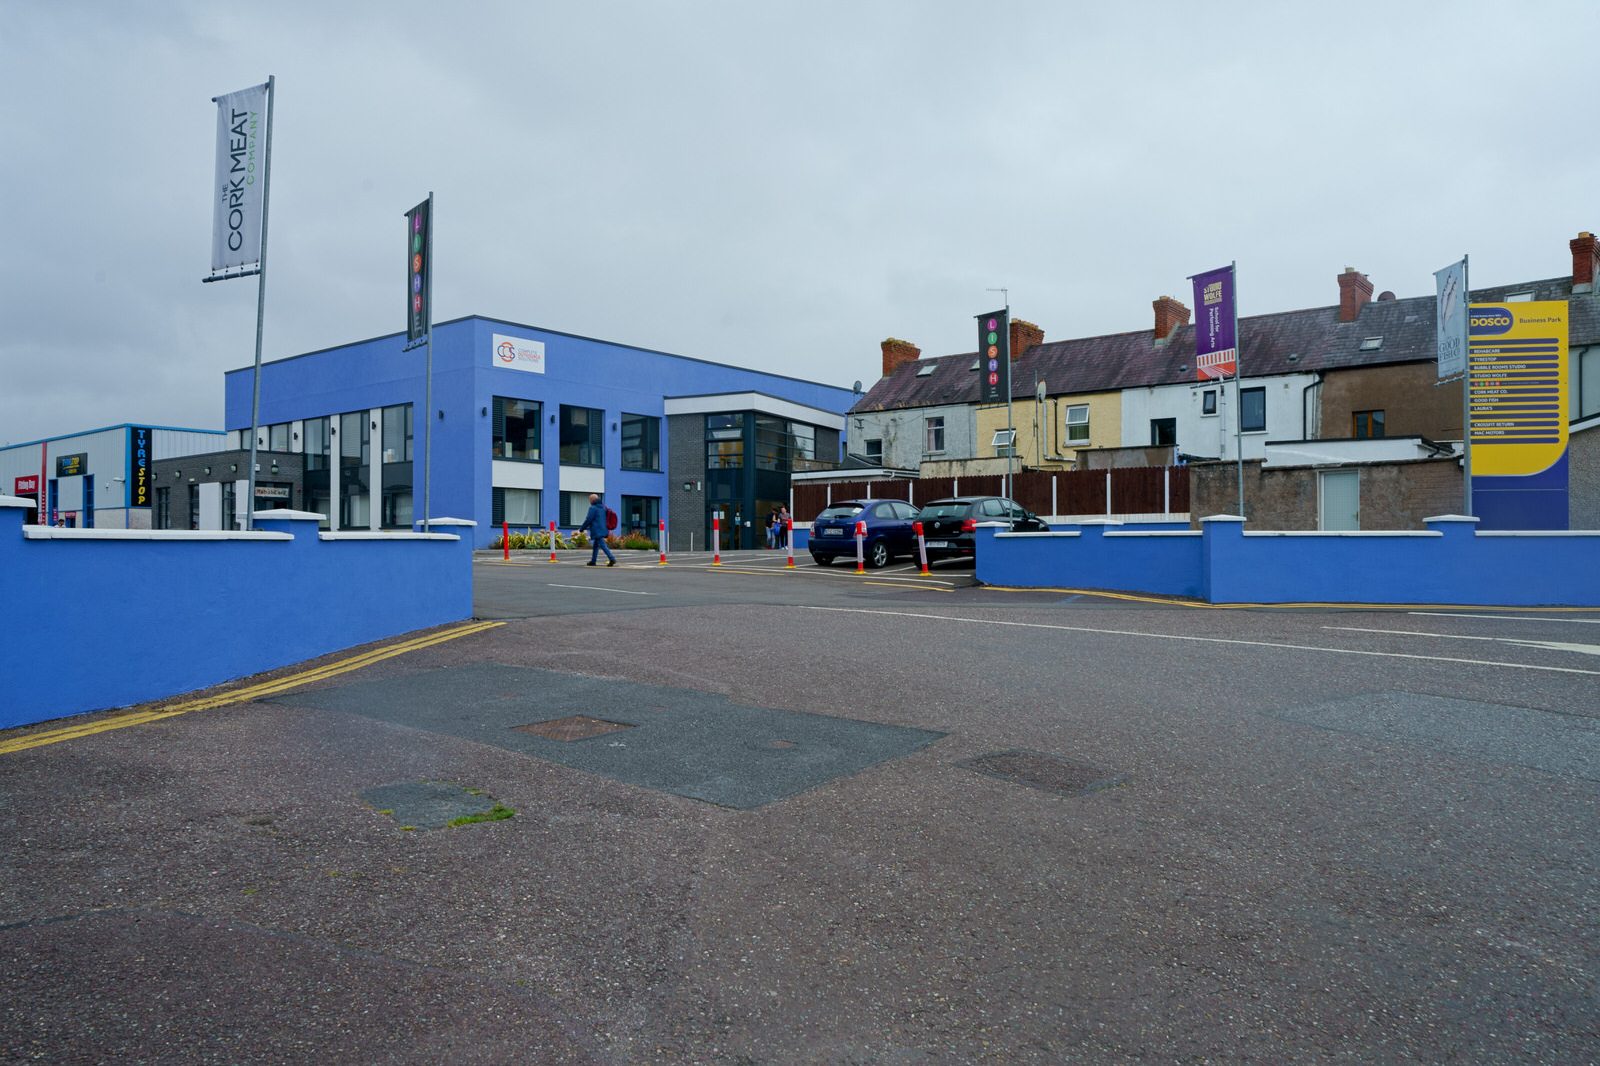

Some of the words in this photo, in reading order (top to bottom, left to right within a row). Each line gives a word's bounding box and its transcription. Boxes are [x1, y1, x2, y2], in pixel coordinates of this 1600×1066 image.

[230, 109, 248, 171] MEAT
[246, 111, 258, 185] COMPANY
[228, 176, 245, 251] CORK
[1204, 282, 1222, 294] STUDIO
[1204, 291, 1222, 302] WOLFE
[1470, 317, 1510, 327] DOSCO
[989, 320, 998, 384] LISHH
[1439, 337, 1460, 353] GOOD
